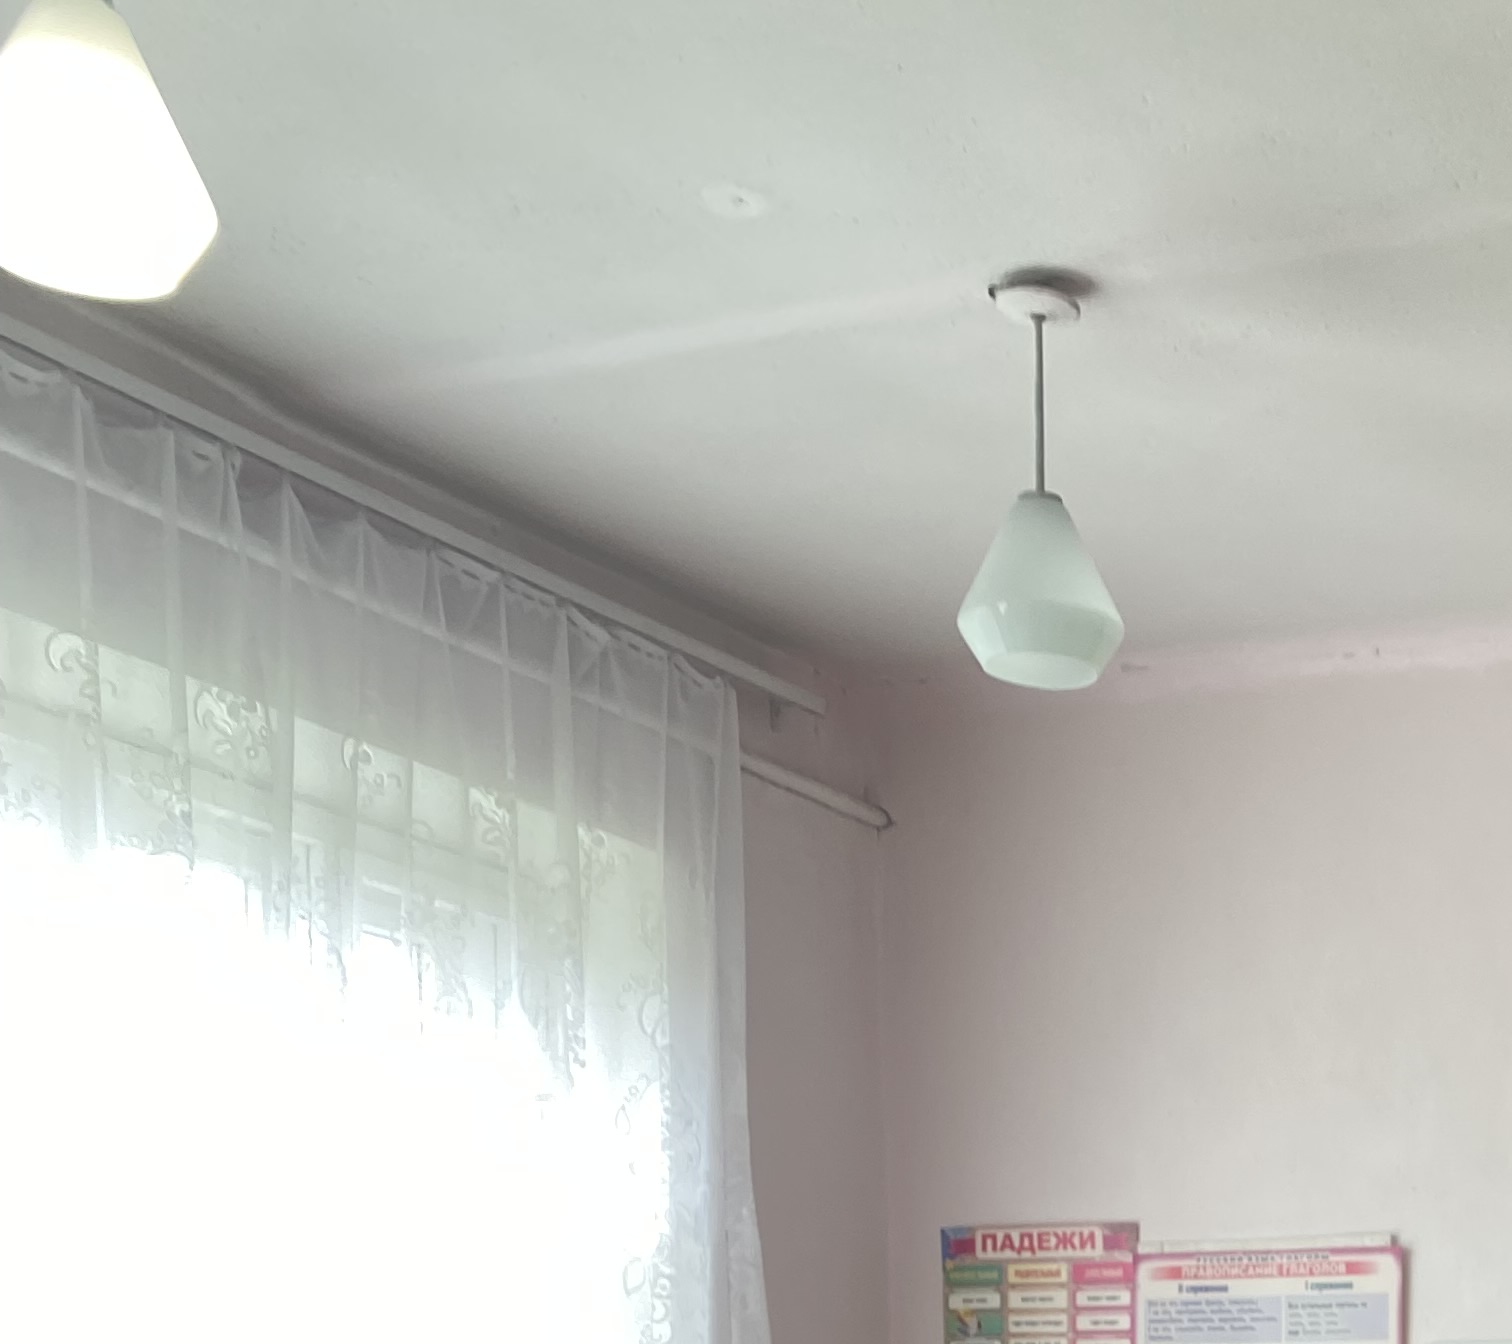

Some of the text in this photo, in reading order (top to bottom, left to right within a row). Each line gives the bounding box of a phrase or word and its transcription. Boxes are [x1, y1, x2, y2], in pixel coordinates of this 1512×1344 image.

[981, 1230, 1096, 1255] ПАДЕЖИ
[1183, 1261, 1346, 1279] ПРАВОПИСАНИЕ ГЛАГОЛОВ
